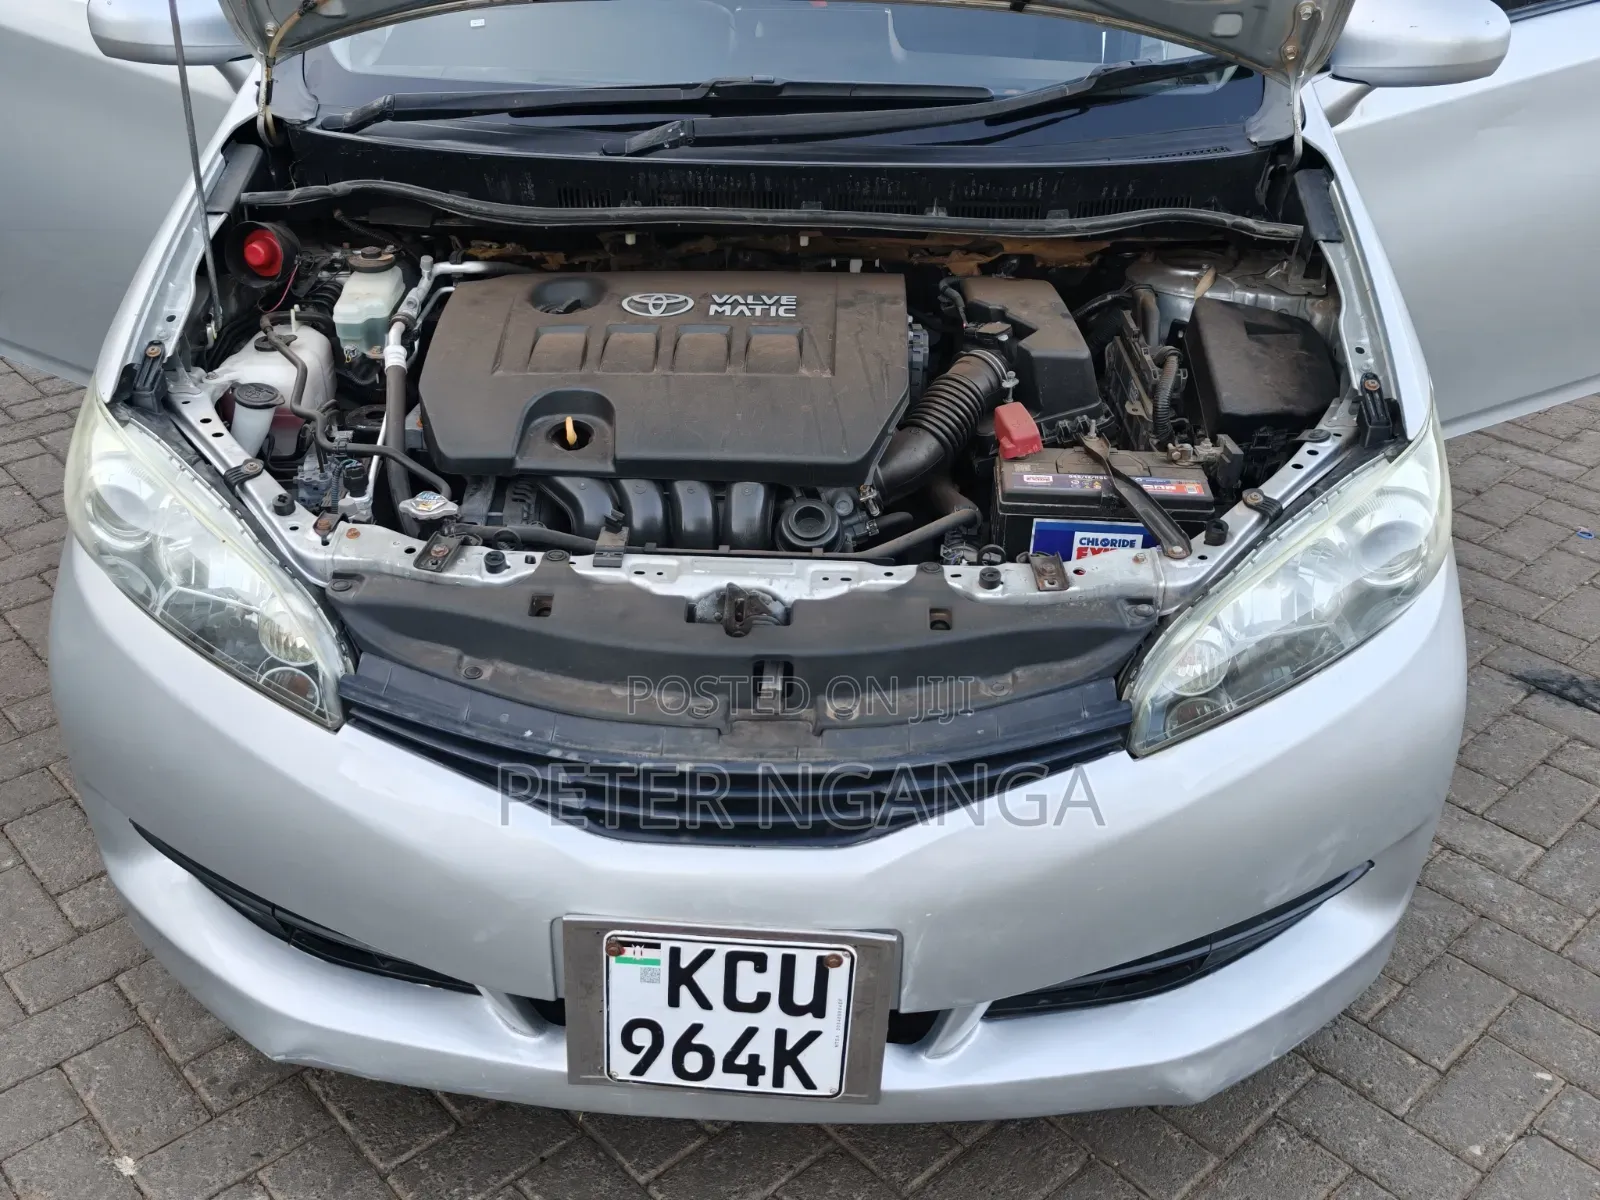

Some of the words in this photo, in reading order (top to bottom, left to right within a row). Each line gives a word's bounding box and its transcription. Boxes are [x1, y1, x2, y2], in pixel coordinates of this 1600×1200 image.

[711, 294, 797, 305] VALVE
[708, 305, 797, 317] MATIC
[1079, 537, 1137, 548] CHLORIDE
[667, 945, 830, 1020] KCU
[620, 1017, 823, 1090] 964K
